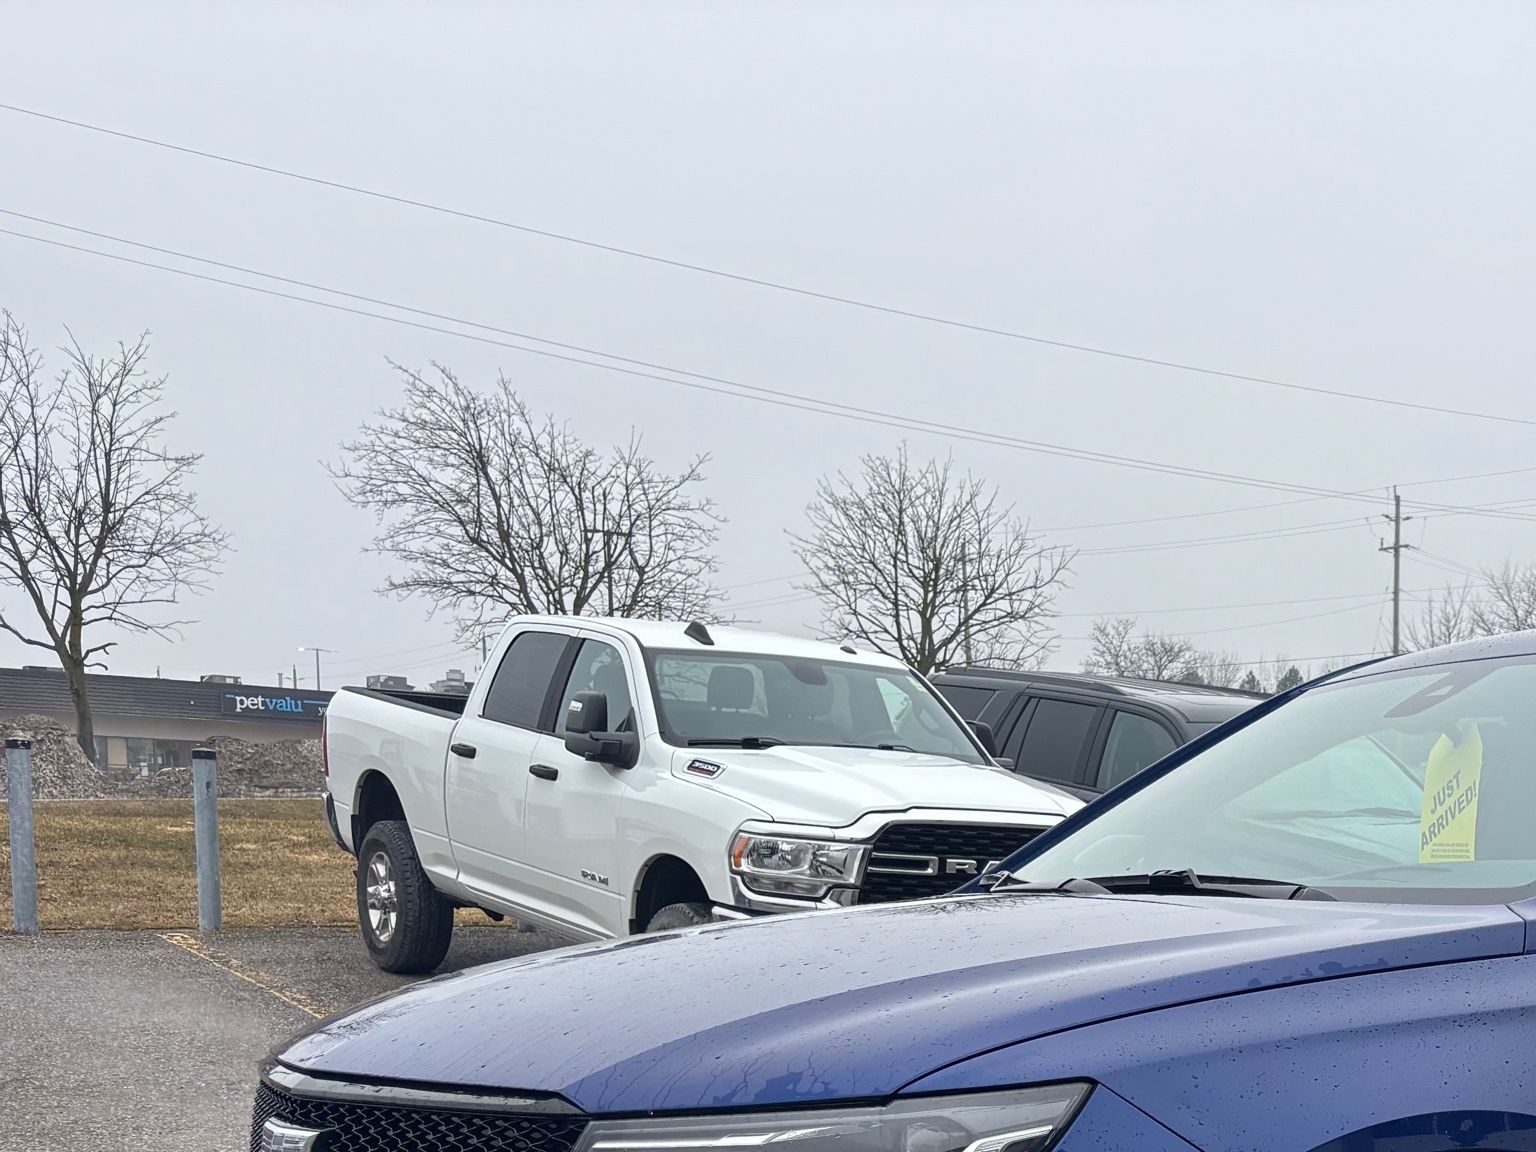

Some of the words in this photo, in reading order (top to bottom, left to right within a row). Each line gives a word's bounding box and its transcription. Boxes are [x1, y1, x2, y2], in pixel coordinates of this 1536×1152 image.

[692, 762, 717, 771] 3500
[1431, 769, 1460, 815] JUST
[1421, 780, 1476, 852] ARRIVED!
